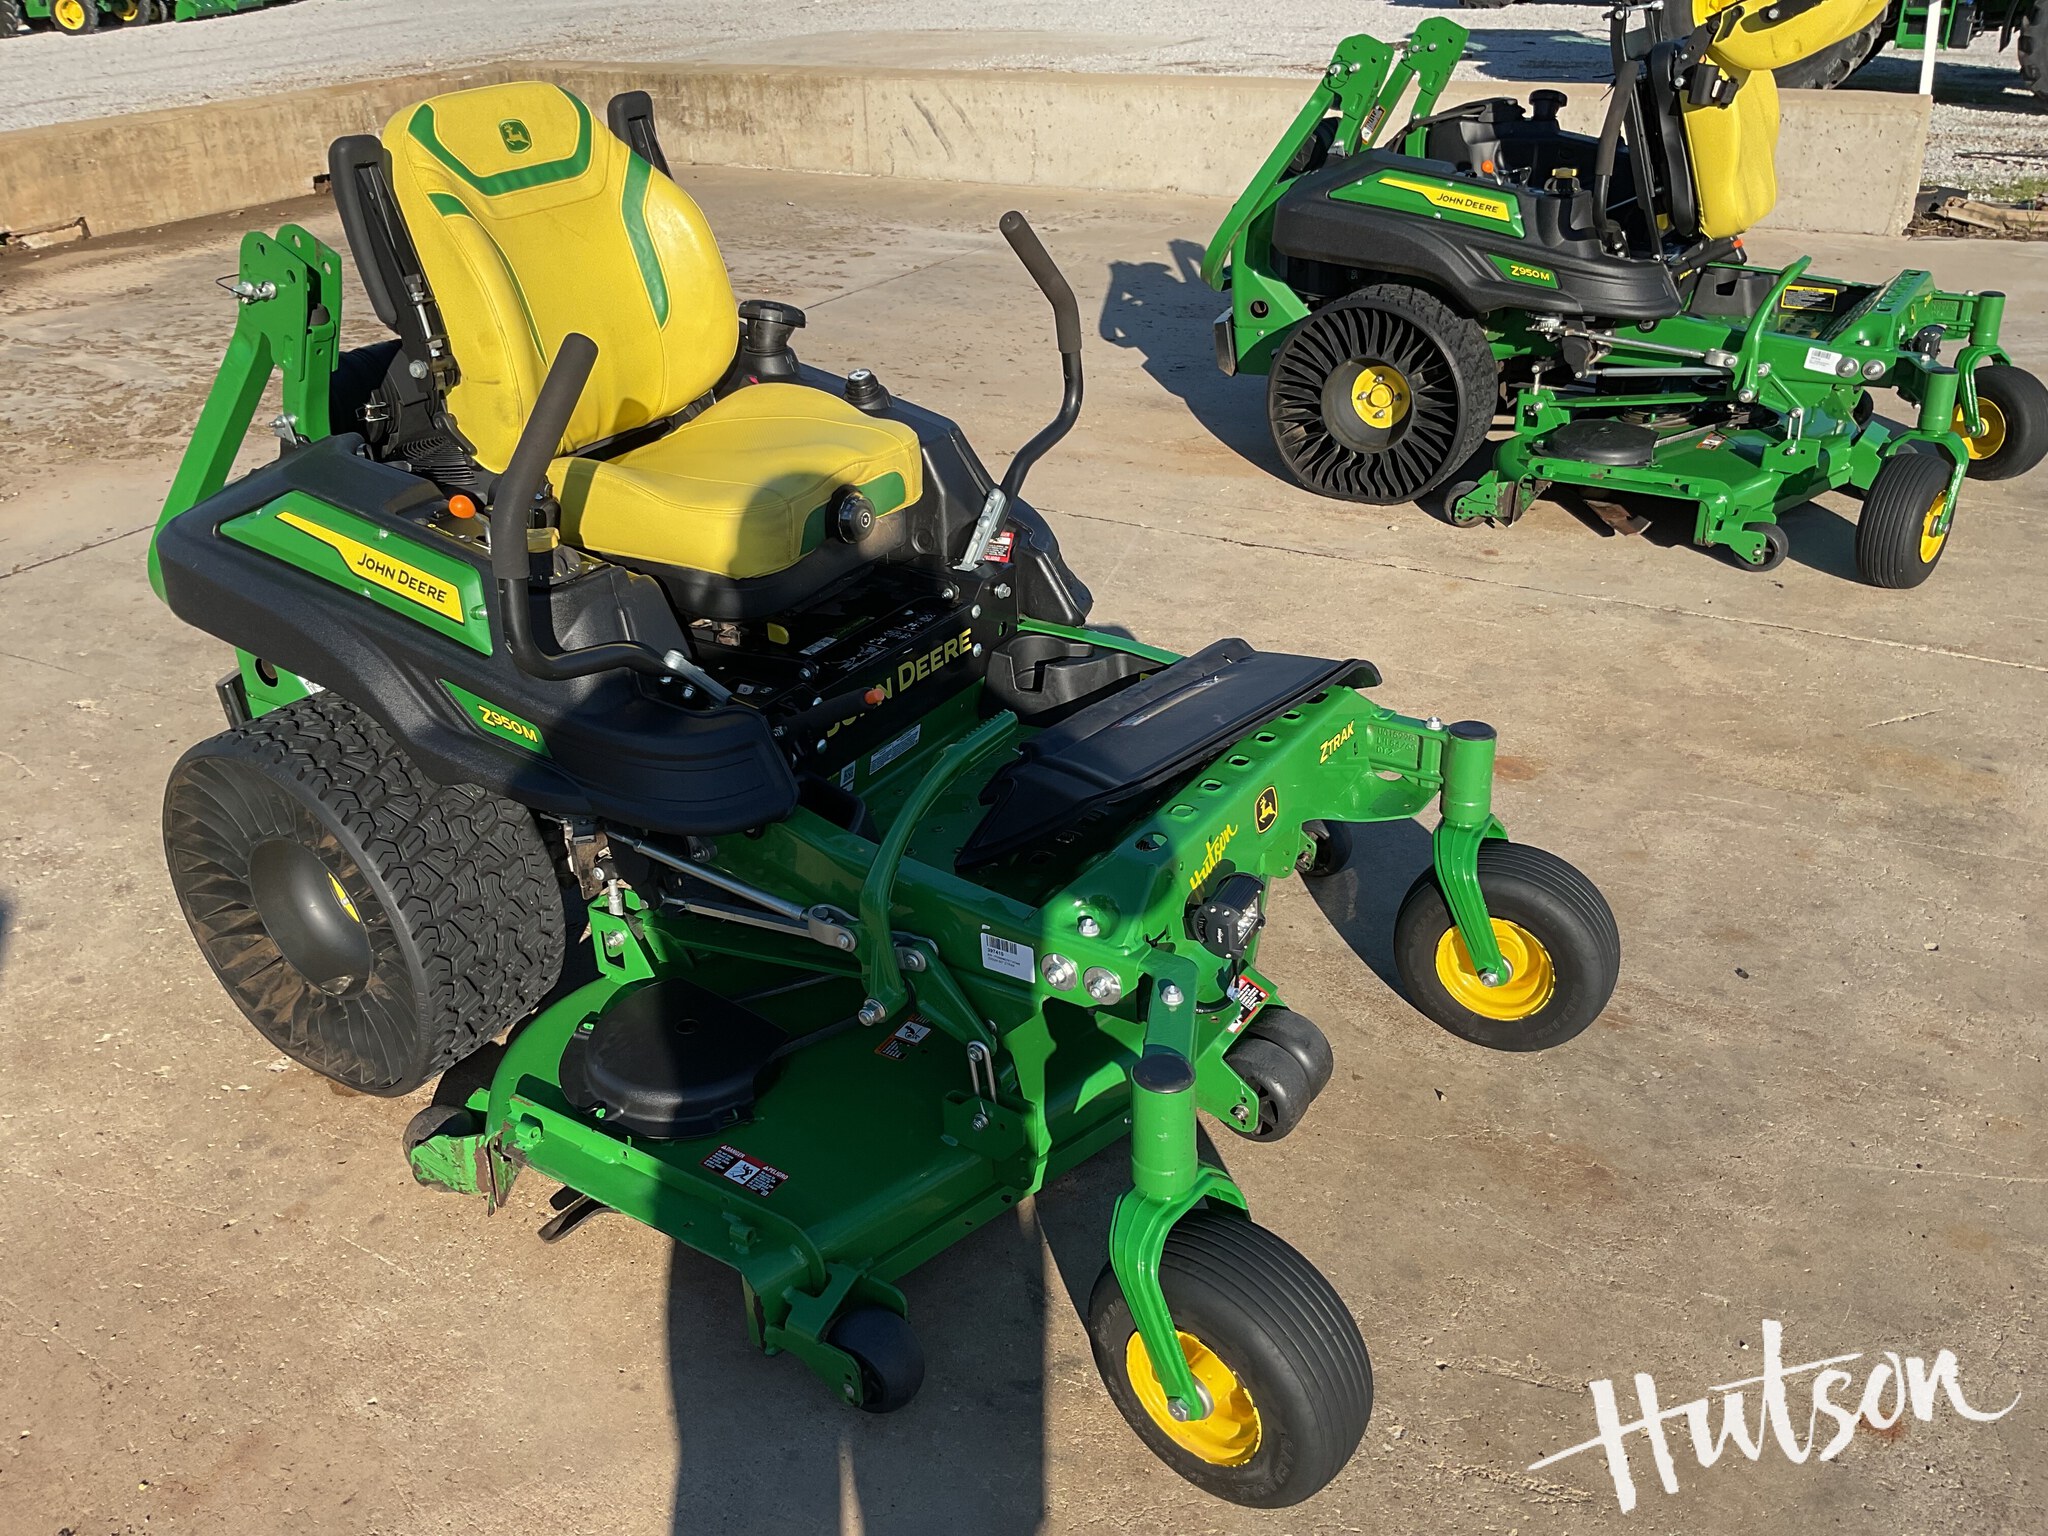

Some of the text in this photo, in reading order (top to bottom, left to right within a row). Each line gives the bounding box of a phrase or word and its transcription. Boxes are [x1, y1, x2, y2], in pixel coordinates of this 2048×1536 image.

[1437, 193, 1499, 213] JOHN DEERE
[1510, 265, 1550, 281] Z950M
[357, 553, 447, 604] JOHN DEERE
[897, 627, 973, 692] DEERE
[477, 704, 539, 743] Z950M
[1319, 719, 1355, 765] ZTRAK
[726, 1146, 746, 1159] DANGER
[767, 1166, 789, 1180] PELIGRO
